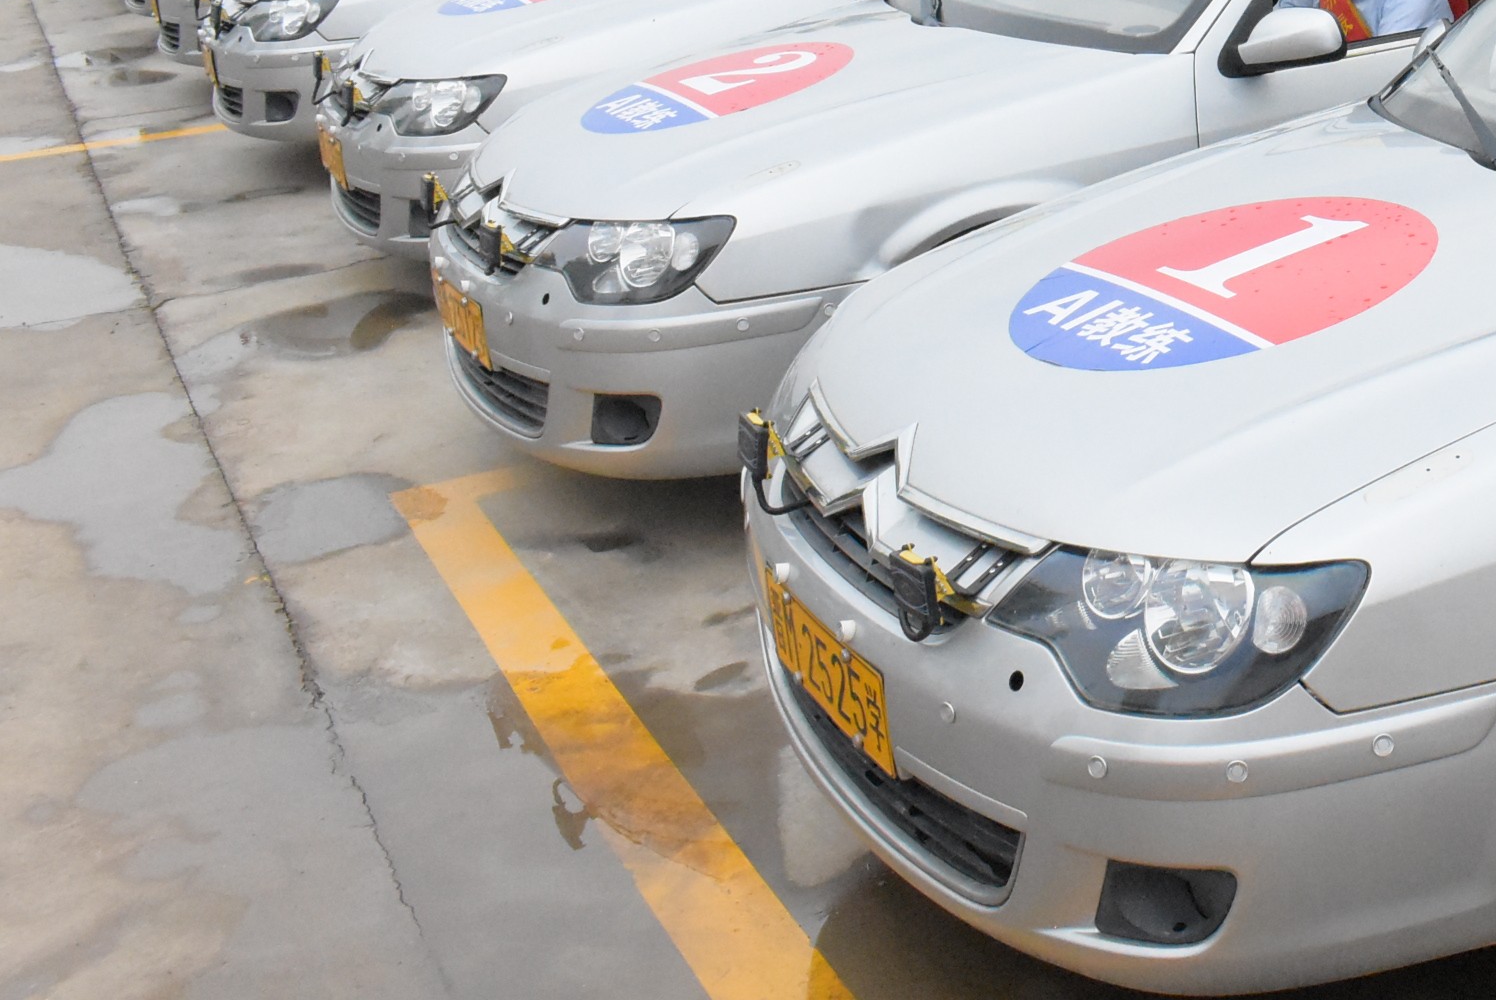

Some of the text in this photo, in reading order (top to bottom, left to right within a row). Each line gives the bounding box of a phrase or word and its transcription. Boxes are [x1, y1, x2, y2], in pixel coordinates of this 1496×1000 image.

[678, 50, 817, 96] 2
[596, 94, 679, 130] AI教练
[1156, 214, 1370, 299] 1
[1023, 289, 1194, 365] AI教练
